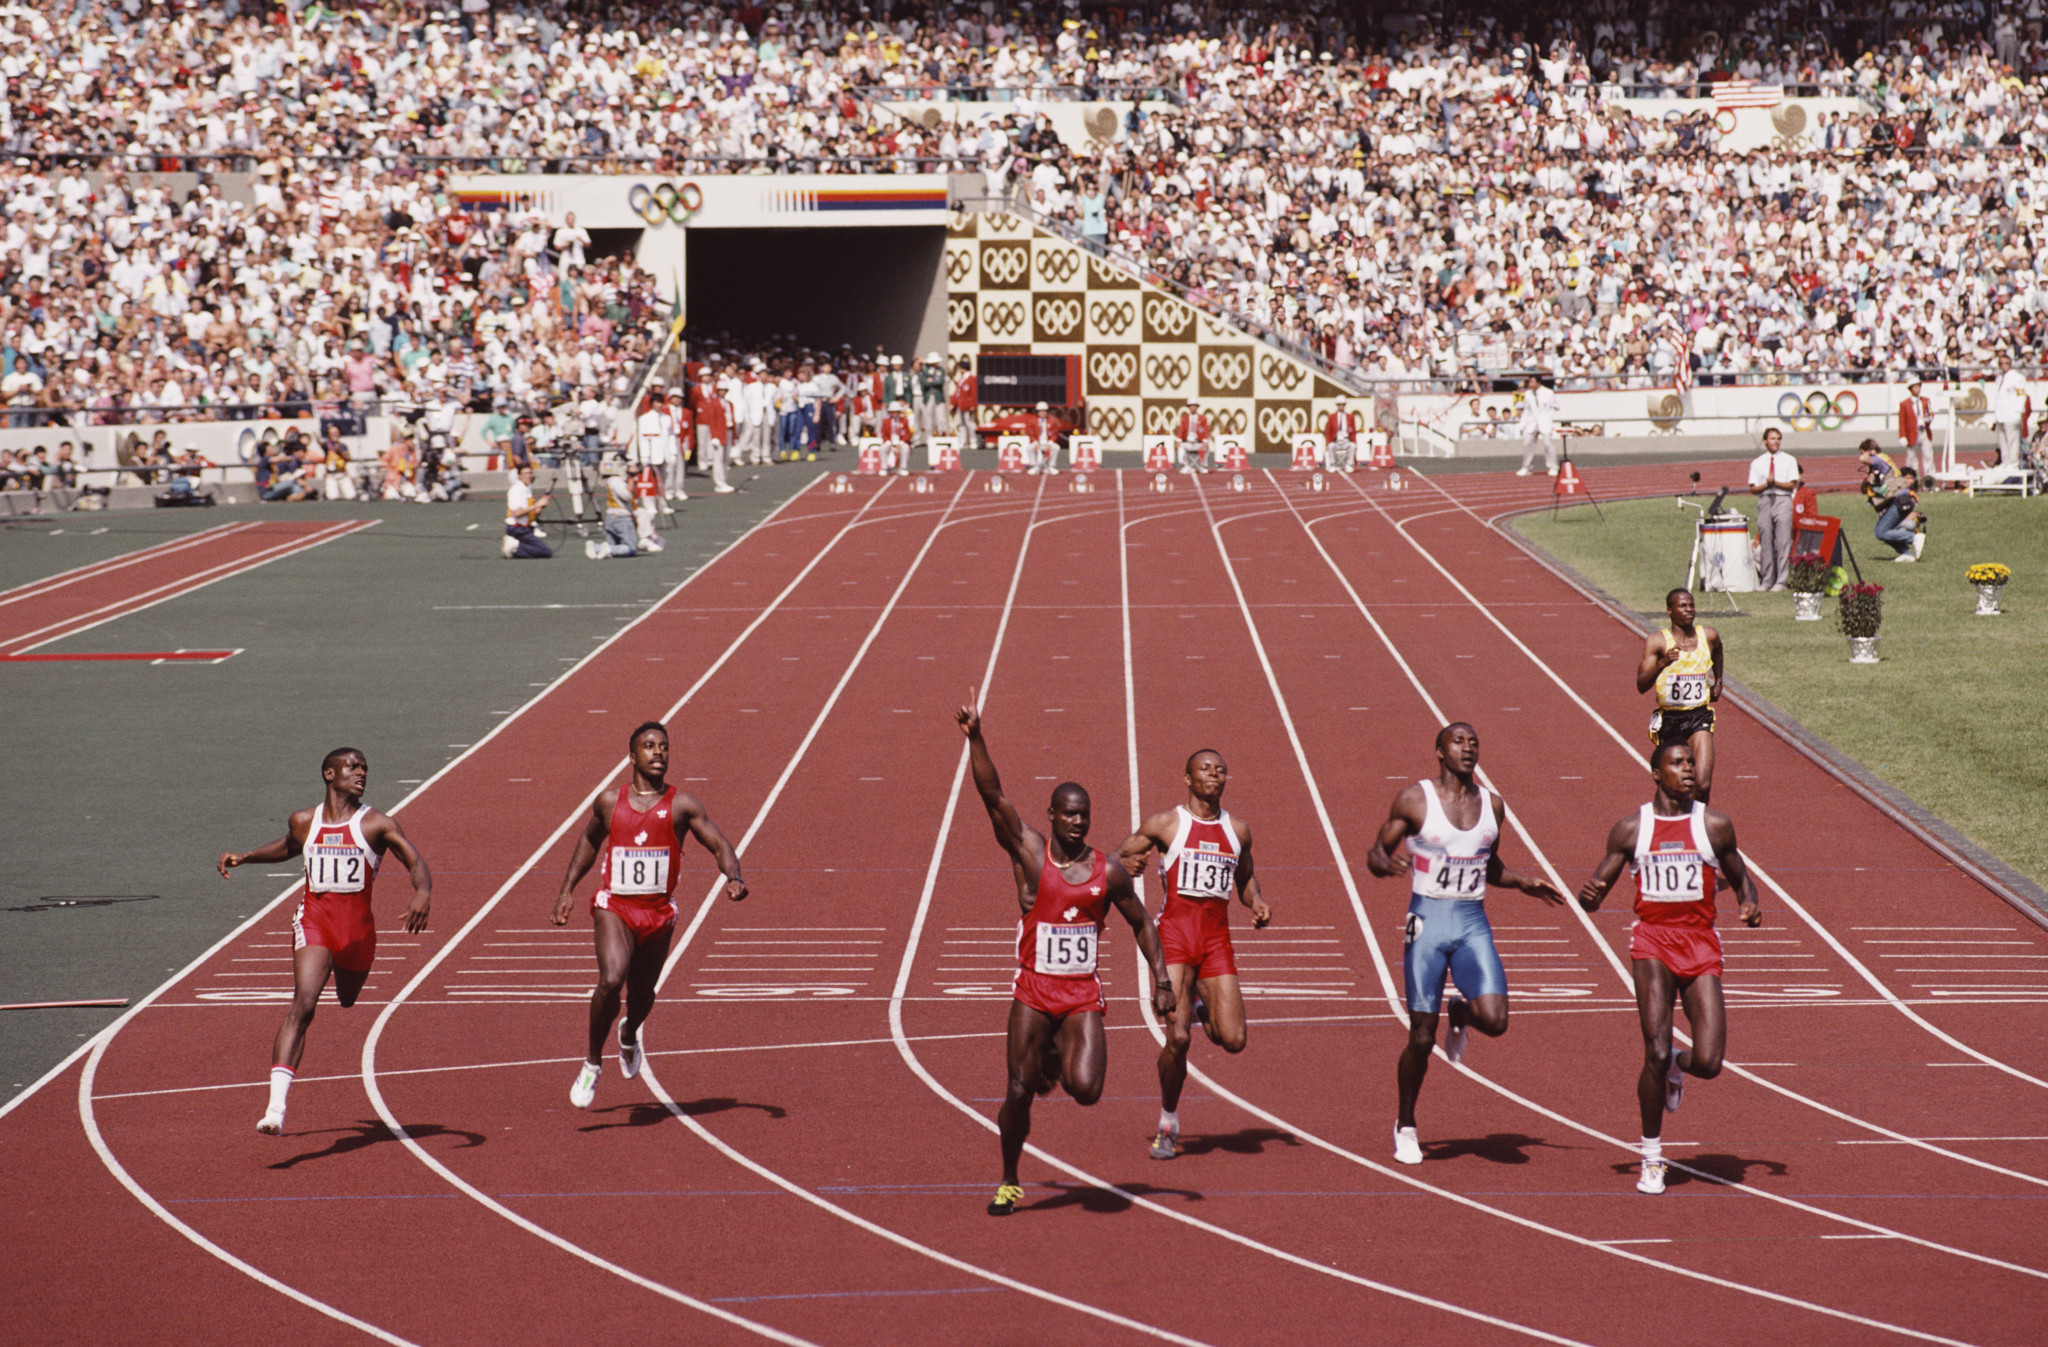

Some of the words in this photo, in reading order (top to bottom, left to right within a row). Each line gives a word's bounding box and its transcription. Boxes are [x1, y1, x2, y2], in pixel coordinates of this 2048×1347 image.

[1671, 682, 1702, 701] 623
[309, 857, 360, 883] 1112
[621, 860, 659, 885] 181
[1182, 861, 1231, 891] 1130
[1436, 866, 1481, 892] 413
[1644, 864, 1698, 891] 1102
[1405, 915, 1416, 943] 4
[1047, 936, 1088, 964] 159
